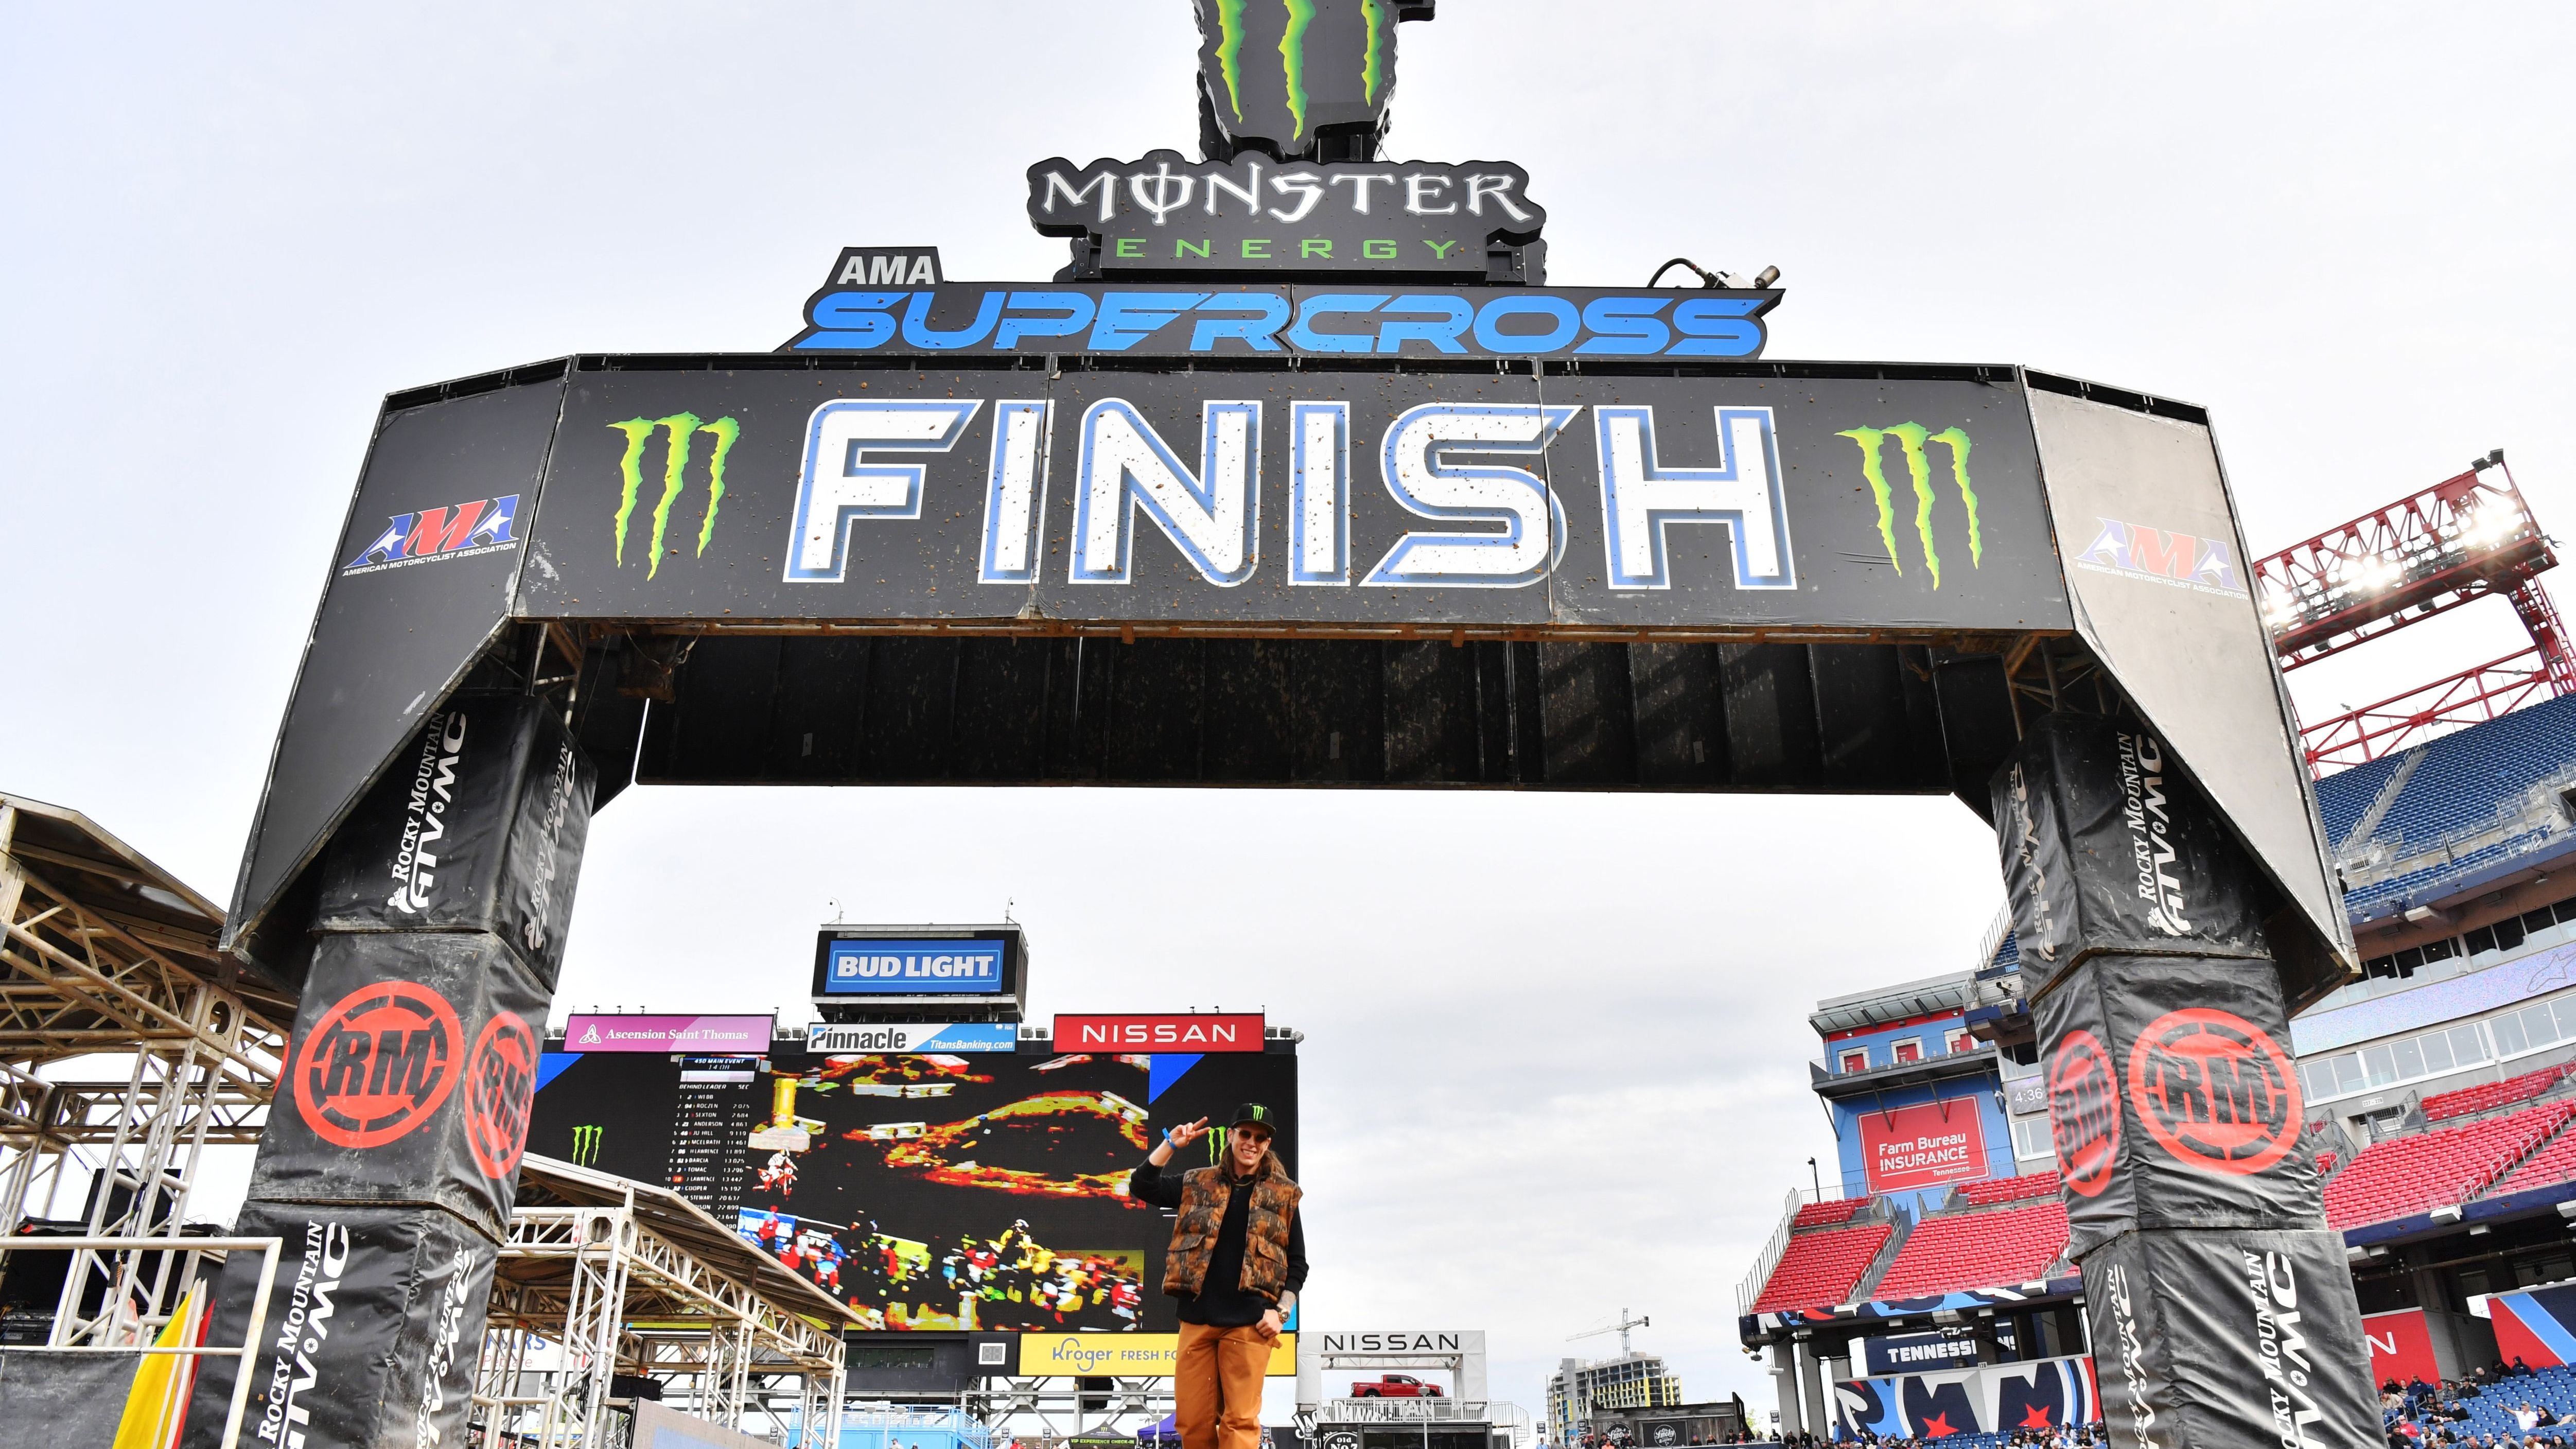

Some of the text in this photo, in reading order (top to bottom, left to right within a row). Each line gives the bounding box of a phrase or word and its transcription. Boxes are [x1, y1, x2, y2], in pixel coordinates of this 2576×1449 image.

[1043, 163, 1533, 225] MONSTER
[1116, 239, 1457, 260] ENERGY
[837, 256, 934, 284] AMA
[793, 291, 1768, 356] SUPERCROSS
[782, 398, 1798, 591] FINISH
[343, 494, 520, 568] AMA
[342, 543, 516, 577] AMERICAN MOTORCYCLIST ASSOCIATION
[2073, 516, 2249, 592] AMA
[2077, 562, 2249, 601] AMERICAN MOTORCYCLIST ASSOCIATION
[392, 713, 445, 883] ROCKY MOUNTAIN
[531, 741, 568, 912] ROCKY MOUNTAIN
[2116, 731, 2156, 903] ROCKY MOUNTAIN
[2027, 875, 2043, 934] ROCKY
[837, 956, 994, 977] BUD LIGHT
[605, 1029, 749, 1040] Ascension Saint Thomas
[811, 1027, 906, 1049] Pinnacle
[930, 1039, 1013, 1051] TitansBanking.com
[1082, 1024, 1235, 1043] NISSAN
[2016, 1088, 2042, 1103] 4:36
[1879, 1133, 1966, 1156] Farm Bureau
[1880, 1146, 1968, 1172] INSURANCE
[1933, 1166, 1970, 1176] Tennessee
[258, 1220, 323, 1444] ROCKY MOUNTAIN
[416, 1243, 462, 1449] ROCKY MOUNTAIN
[1324, 1334, 1459, 1351] NISSAN
[2107, 1266, 2137, 1395] MOUNTAIN
[1053, 1337, 1113, 1372] Kroger
[1121, 1350, 1159, 1360] FRESH
[2243, 1250, 2300, 1449] OCKY MOUNTAIN
